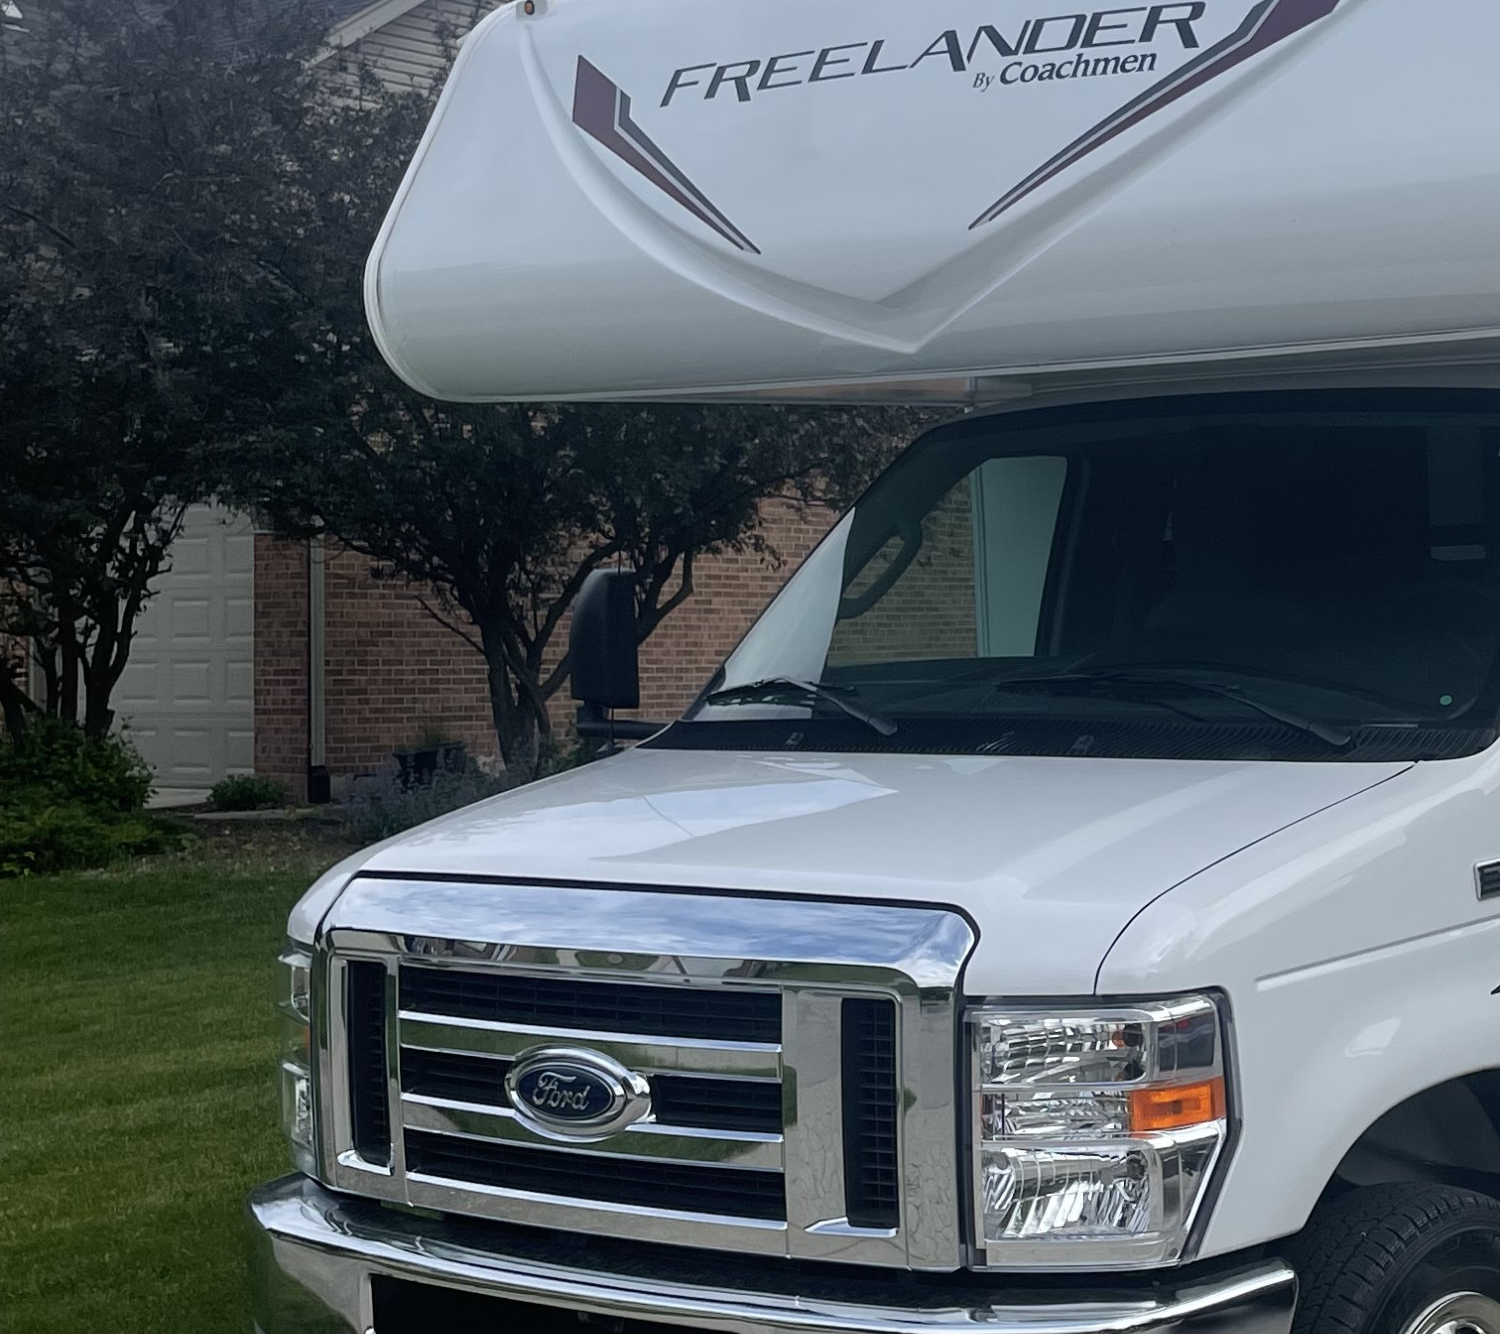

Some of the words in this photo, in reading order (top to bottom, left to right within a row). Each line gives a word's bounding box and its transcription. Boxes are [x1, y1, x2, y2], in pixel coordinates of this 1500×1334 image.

[659, 0, 1206, 107] FREELANDER
[972, 72, 995, 92] By
[999, 51, 1158, 85] Coachmen
[532, 1071, 591, 1110] Ford
